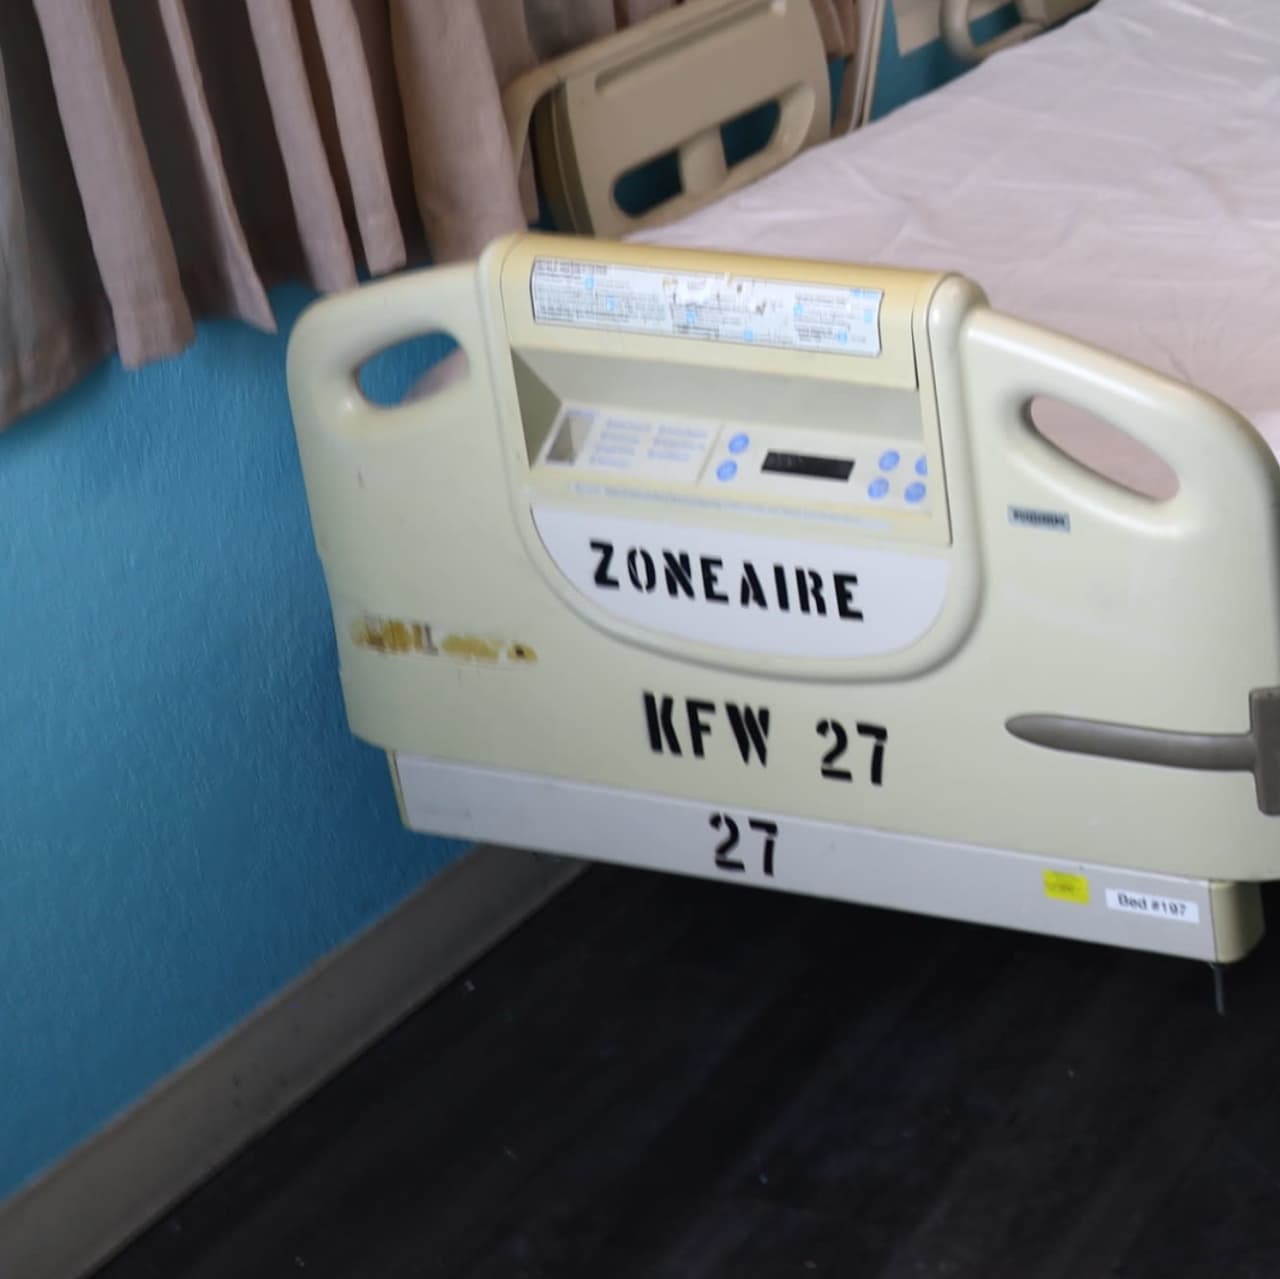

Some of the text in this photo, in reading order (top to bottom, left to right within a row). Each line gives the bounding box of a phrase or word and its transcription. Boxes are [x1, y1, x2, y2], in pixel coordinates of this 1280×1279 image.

[589, 539, 864, 622] ZONEAIRE
[642, 690, 889, 787] KFW 27
[708, 812, 779, 878] 27
[1117, 892, 1148, 911] Bed
